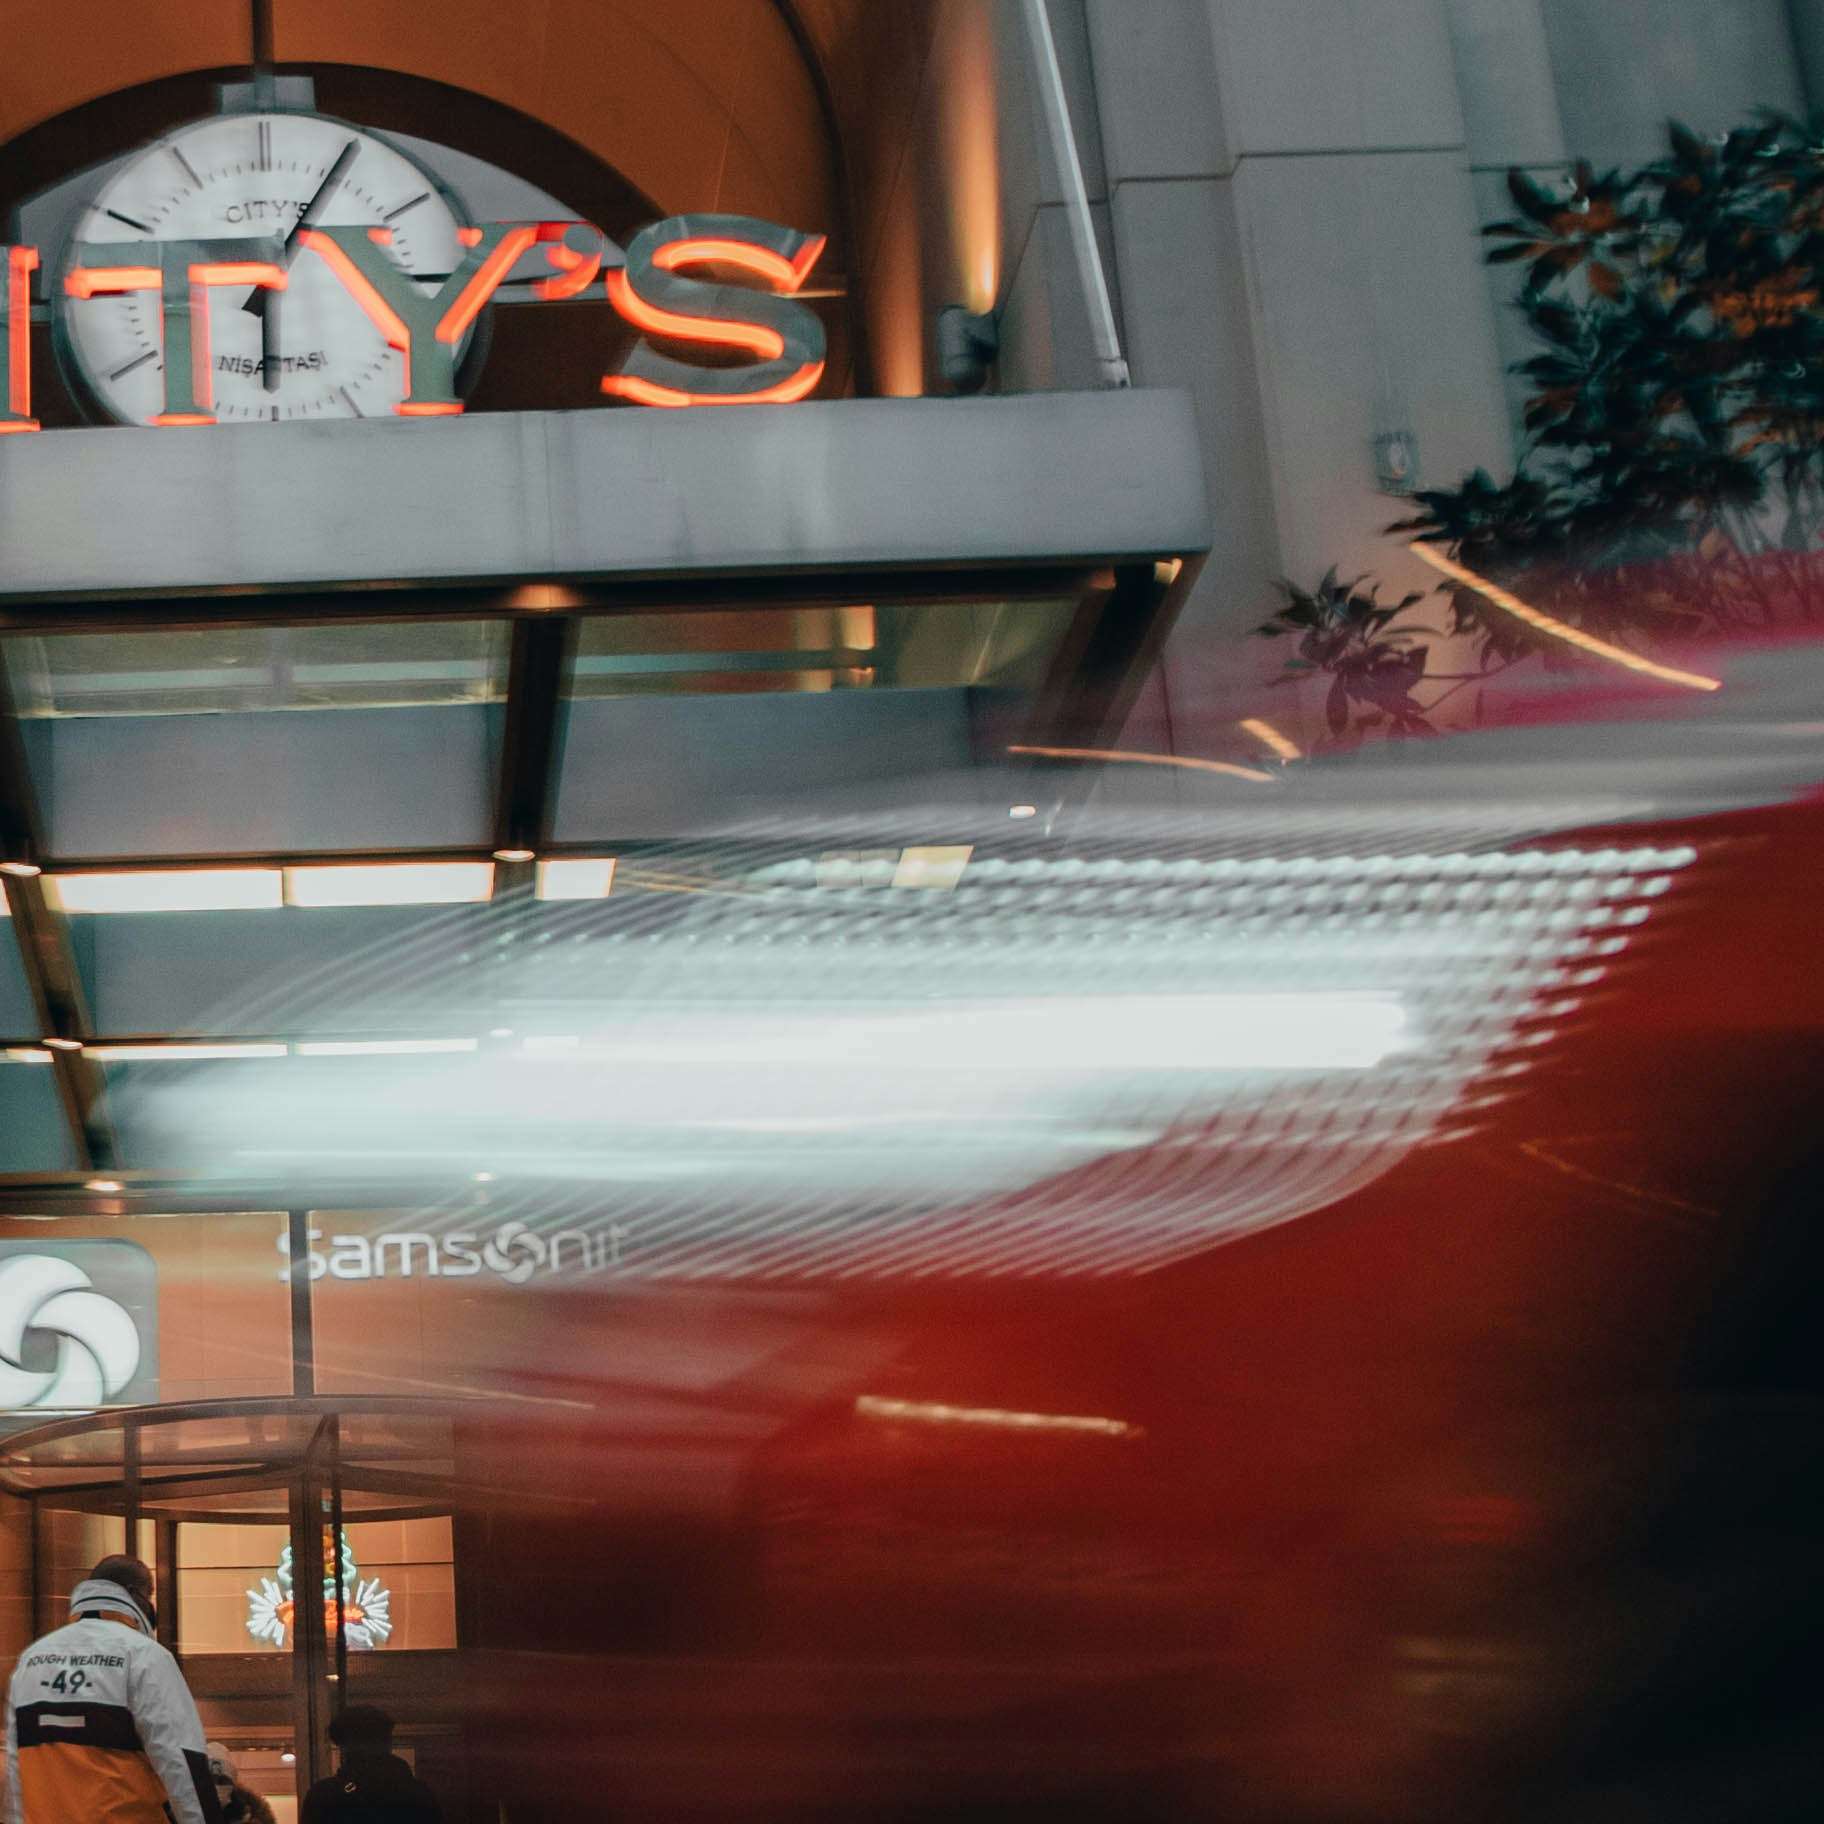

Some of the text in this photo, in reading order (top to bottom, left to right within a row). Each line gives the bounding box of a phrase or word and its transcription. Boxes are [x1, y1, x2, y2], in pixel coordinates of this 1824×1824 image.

[227, 200, 312, 224] CITY'S
[276, 1221, 631, 1286] Samsonit
[69, 1655, 126, 1668] WEATHER
